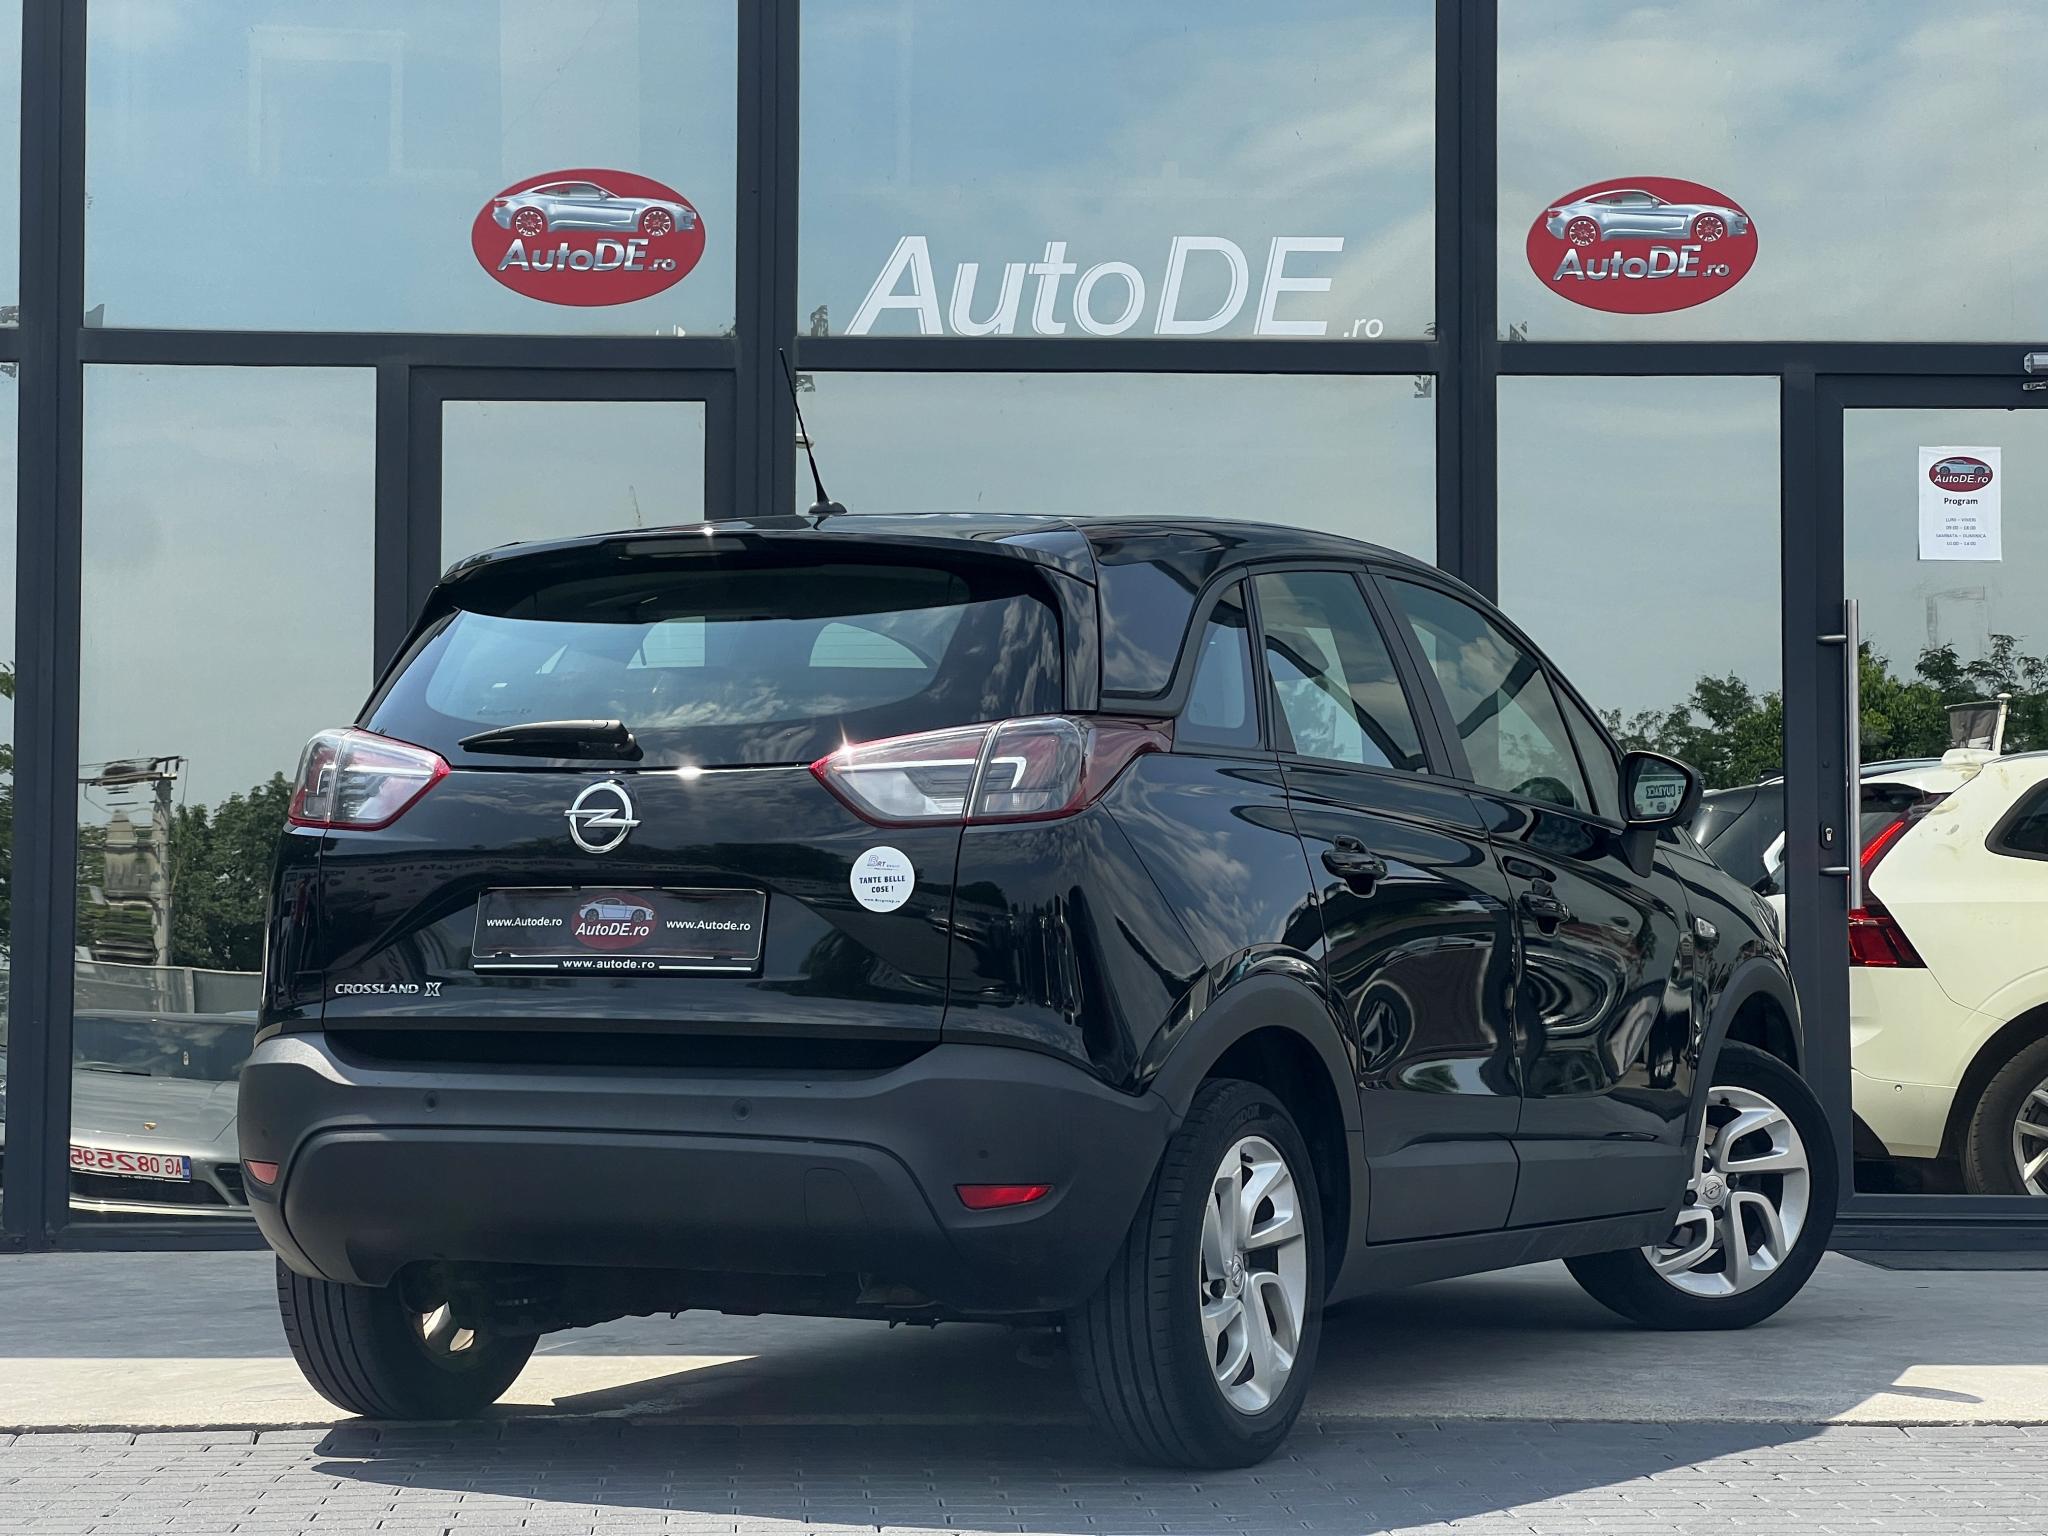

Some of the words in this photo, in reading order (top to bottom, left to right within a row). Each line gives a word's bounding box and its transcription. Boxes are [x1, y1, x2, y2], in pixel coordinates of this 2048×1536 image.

[1933, 474, 1989, 483] AutoDE.ro
[1943, 497, 1978, 506] Program
[859, 876, 882, 884] TANTE
[884, 875, 906, 883] BELLE
[871, 885, 889, 893] COSE
[486, 916, 563, 927] www.Autode.ro
[575, 922, 649, 937] AutoDE.ro
[666, 919, 751, 931] www.Autode.ro
[563, 959, 655, 969] www.autode.ro
[335, 983, 419, 994] CROSSLAND
[423, 982, 442, 997] X
